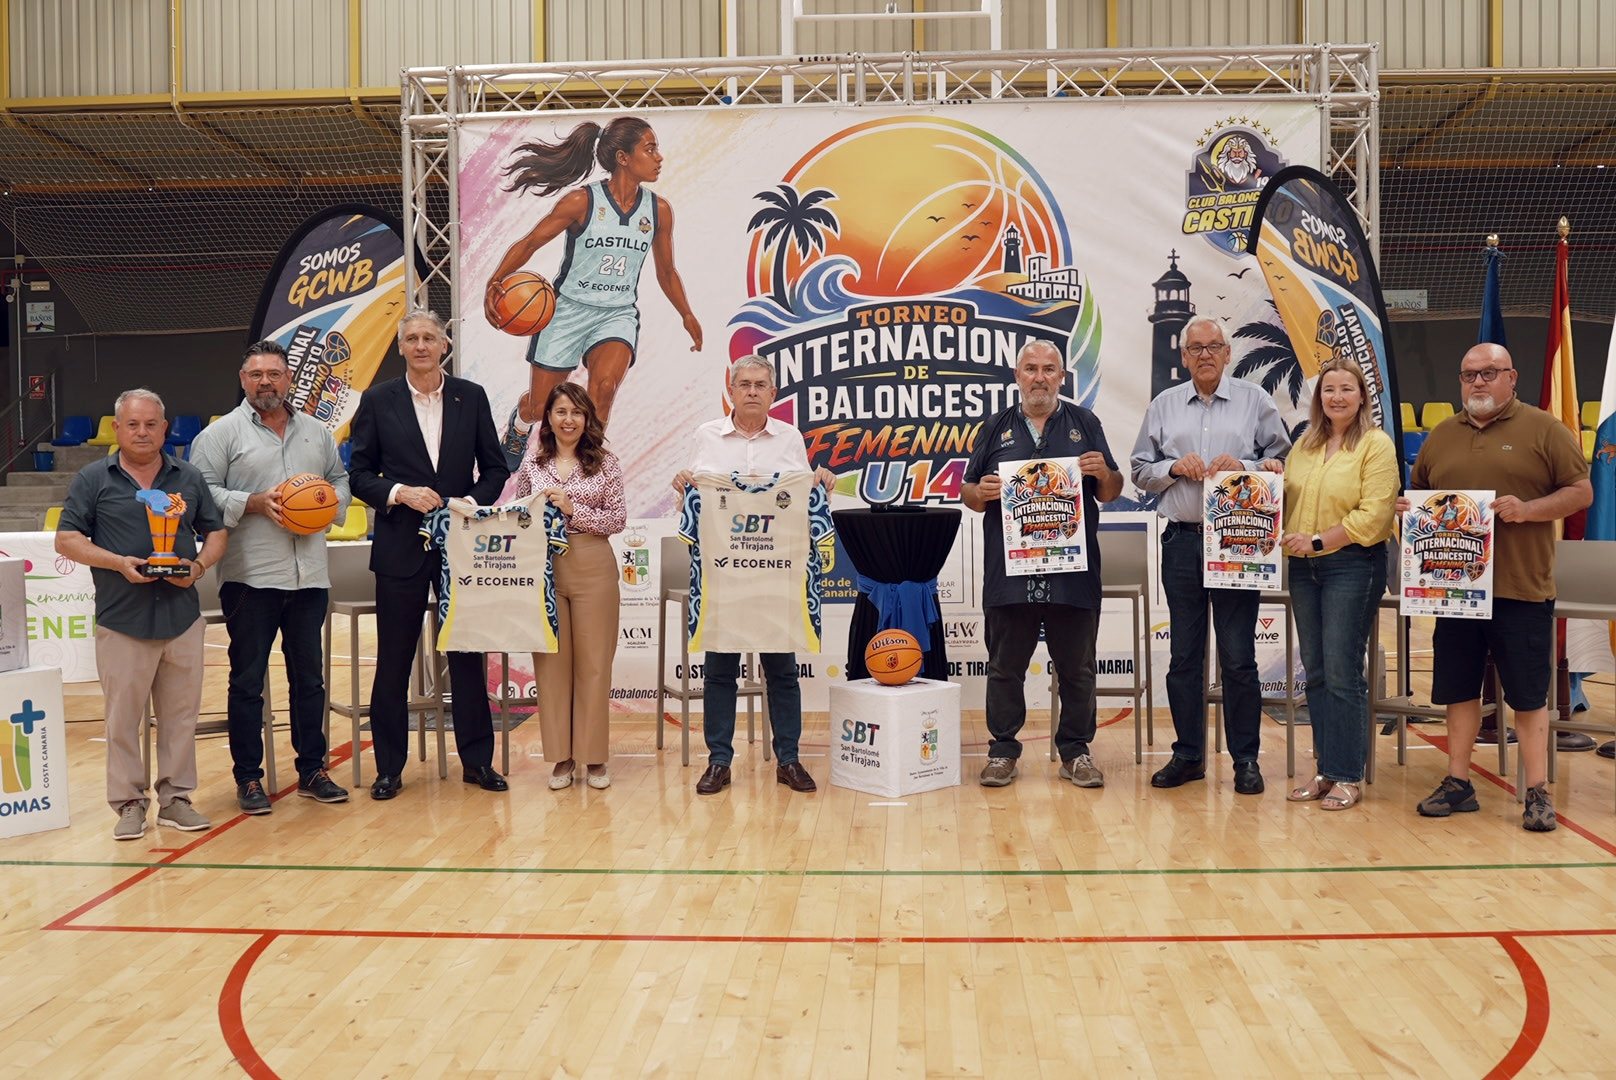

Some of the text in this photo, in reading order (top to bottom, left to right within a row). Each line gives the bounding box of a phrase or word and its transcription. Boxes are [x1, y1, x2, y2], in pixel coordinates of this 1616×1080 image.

[1188, 196, 1216, 209] CLUB
[584, 236, 649, 253] CASTILLO
[299, 242, 361, 275] SOMOS
[599, 254, 627, 277] 24
[287, 258, 374, 309] GCWB
[591, 283, 630, 292] ECOENER
[856, 304, 967, 327] TORNEO
[904, 365, 929, 380] DE
[314, 374, 343, 422] U14
[863, 459, 970, 502] U14
[1014, 502, 1074, 517] INTERNACIONAL
[731, 514, 775, 533] SBT
[1022, 514, 1067, 523] BALONCESTO
[1215, 515, 1272, 531] INTERNACIONAL
[1032, 530, 1058, 541] U14
[1222, 529, 1265, 537] BALONCESTO
[474, 535, 517, 553] SBT
[740, 542, 774, 551] Tirajana
[1230, 544, 1256, 556] U14
[1415, 537, 1482, 554] INTERNACIONAL
[1423, 552, 1473, 560] BALONCESTO
[474, 561, 516, 570] de Tirajana
[733, 559, 792, 569] ECOENER
[477, 577, 534, 586] ECOENER
[1432, 569, 1462, 580] U14
[837, 577, 851, 588] de
[620, 627, 652, 639] ACM
[944, 621, 979, 638] HW
[871, 637, 909, 651] Wilson
[841, 719, 880, 746] SBT
[40, 726, 48, 761] CANARIA
[840, 743, 880, 758] San Bartolomé
[840, 753, 881, 768] de Tirajana
